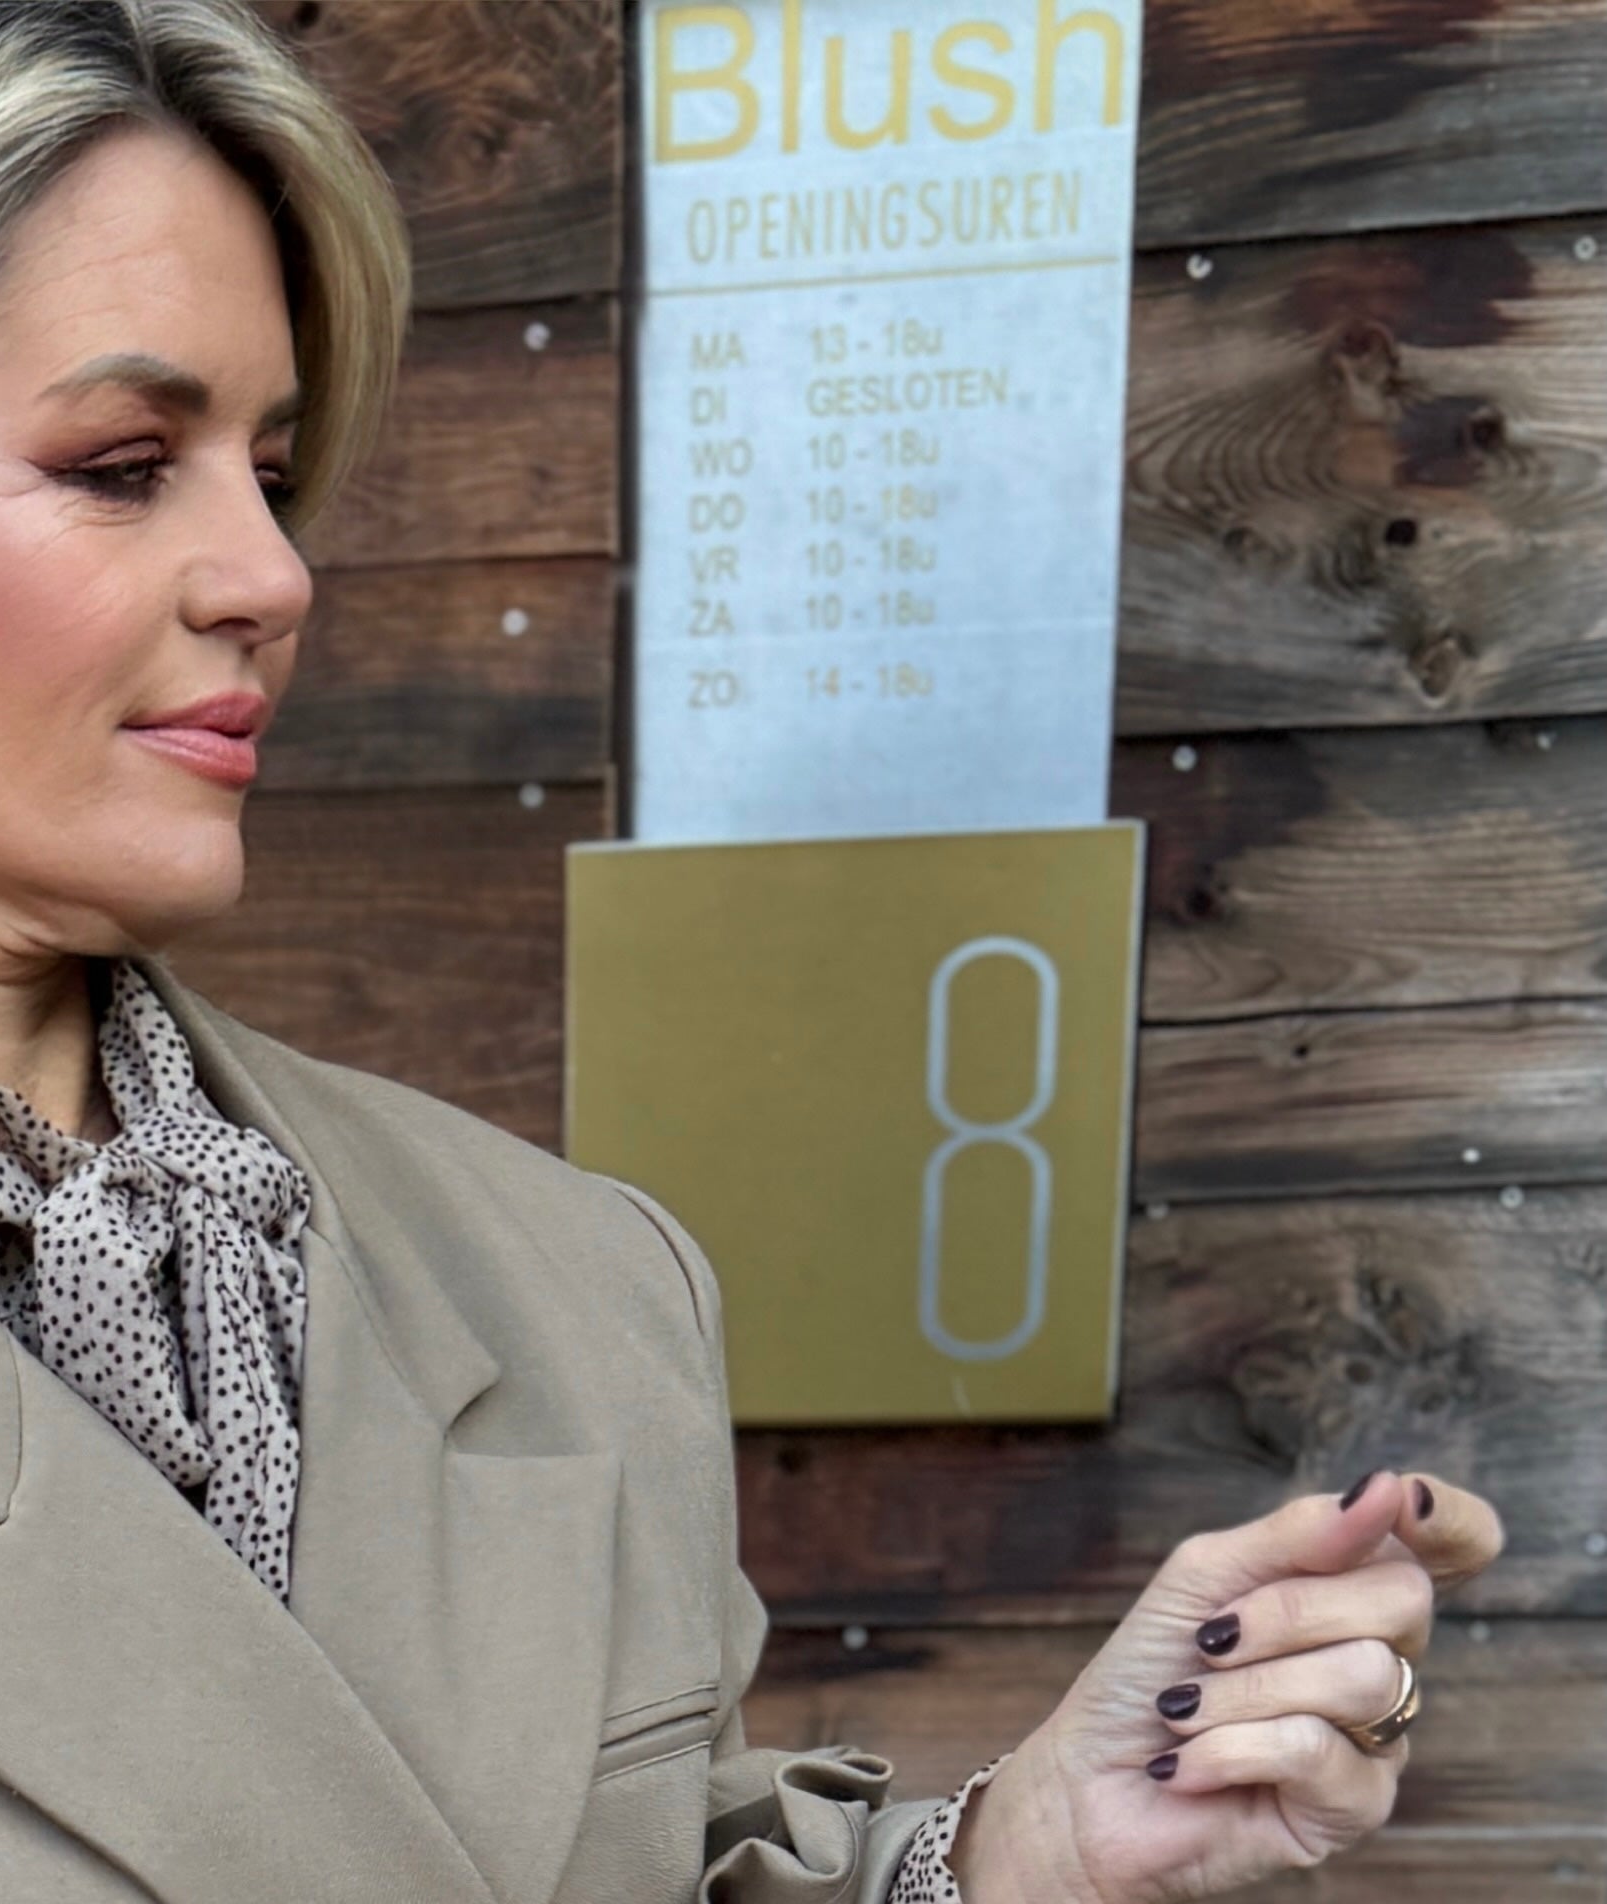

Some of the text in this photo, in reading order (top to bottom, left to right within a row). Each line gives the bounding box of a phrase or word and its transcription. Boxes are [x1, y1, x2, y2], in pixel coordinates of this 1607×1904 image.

[653, 0, 1125, 165] Blush
[686, 169, 1083, 264] OPENINGSUREN
[690, 331, 747, 371] MA
[811, 323, 848, 363] 13
[883, 318, 944, 358] 18u
[691, 366, 1009, 427] DI GESLOTEN
[689, 437, 754, 478] WO
[807, 432, 845, 470] 10
[881, 428, 941, 468] 18u
[689, 492, 744, 533] DO
[806, 486, 845, 526] 10
[881, 482, 938, 521] 18u
[688, 544, 740, 584] VR
[806, 539, 843, 578] 10
[880, 536, 937, 573] 18u
[689, 599, 736, 638] ZA
[806, 593, 842, 631] 10
[878, 589, 936, 627] 18u
[688, 670, 741, 709] ZO
[805, 664, 841, 700] 14
[877, 661, 934, 700] 18u
[919, 935, 1058, 1362] 8
